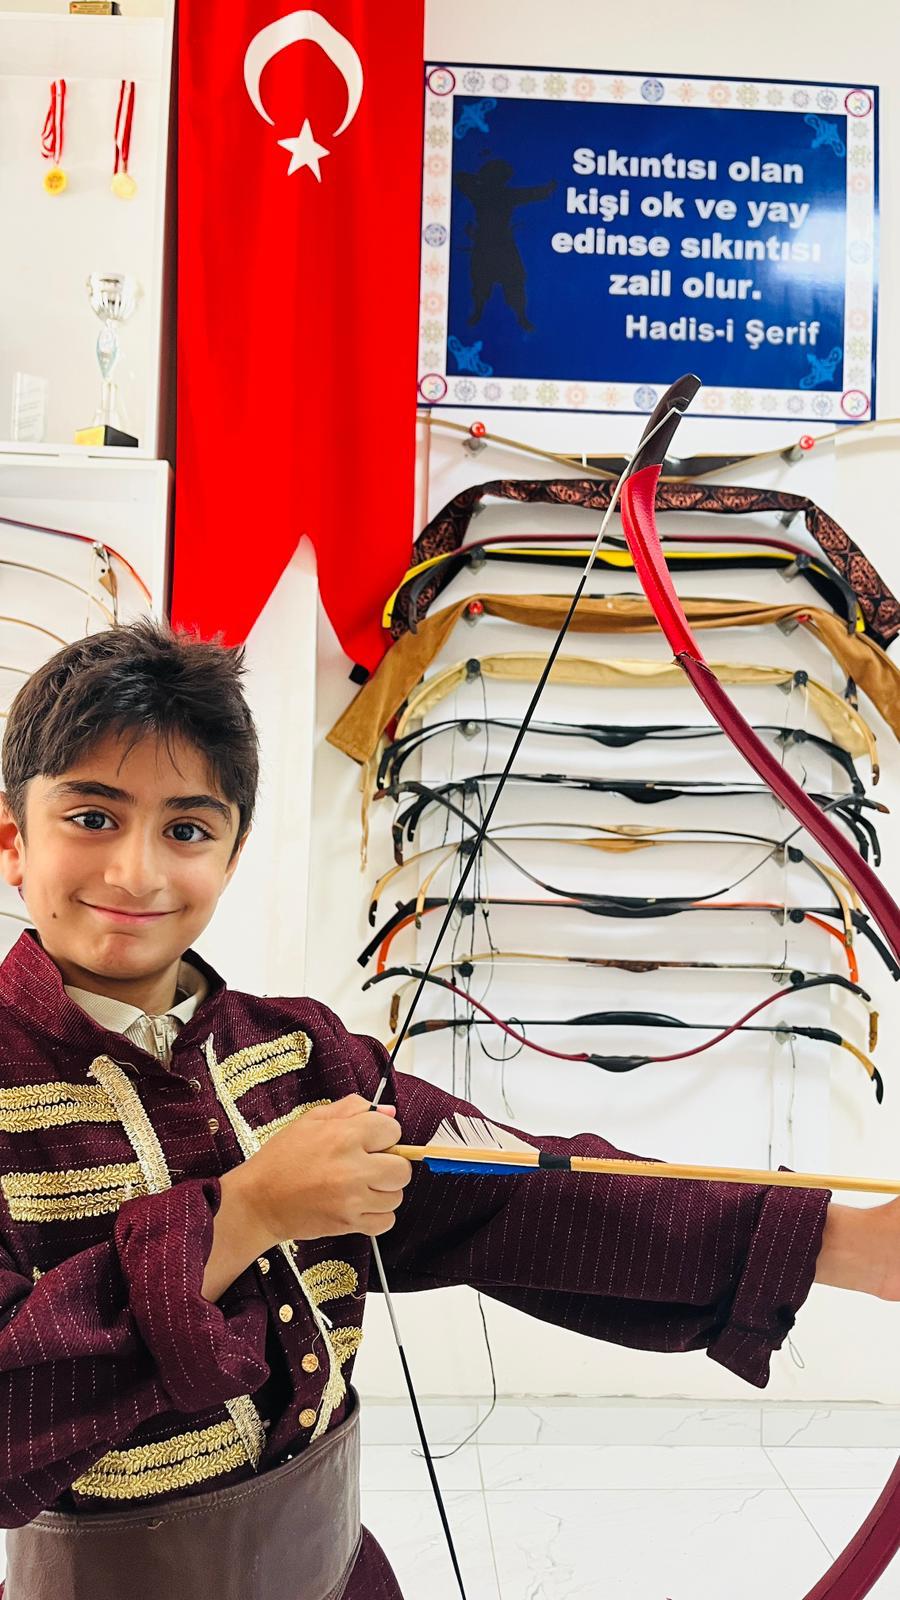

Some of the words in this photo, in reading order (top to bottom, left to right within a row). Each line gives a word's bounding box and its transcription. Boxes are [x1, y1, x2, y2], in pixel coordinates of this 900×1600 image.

[572, 147, 717, 181] Sıkıntısı
[728, 156, 804, 184] olan
[566, 187, 630, 222] kişi
[640, 191, 685, 218] ok
[695, 199, 737, 220] ve
[747, 200, 810, 229] yay
[551, 227, 671, 257] edinse
[681, 232, 821, 263] sıkıntısı
[608, 269, 671, 297] zail
[682, 271, 762, 300] olur.
[625, 314, 734, 343] Hadis-i
[745, 318, 821, 350] Şerif
